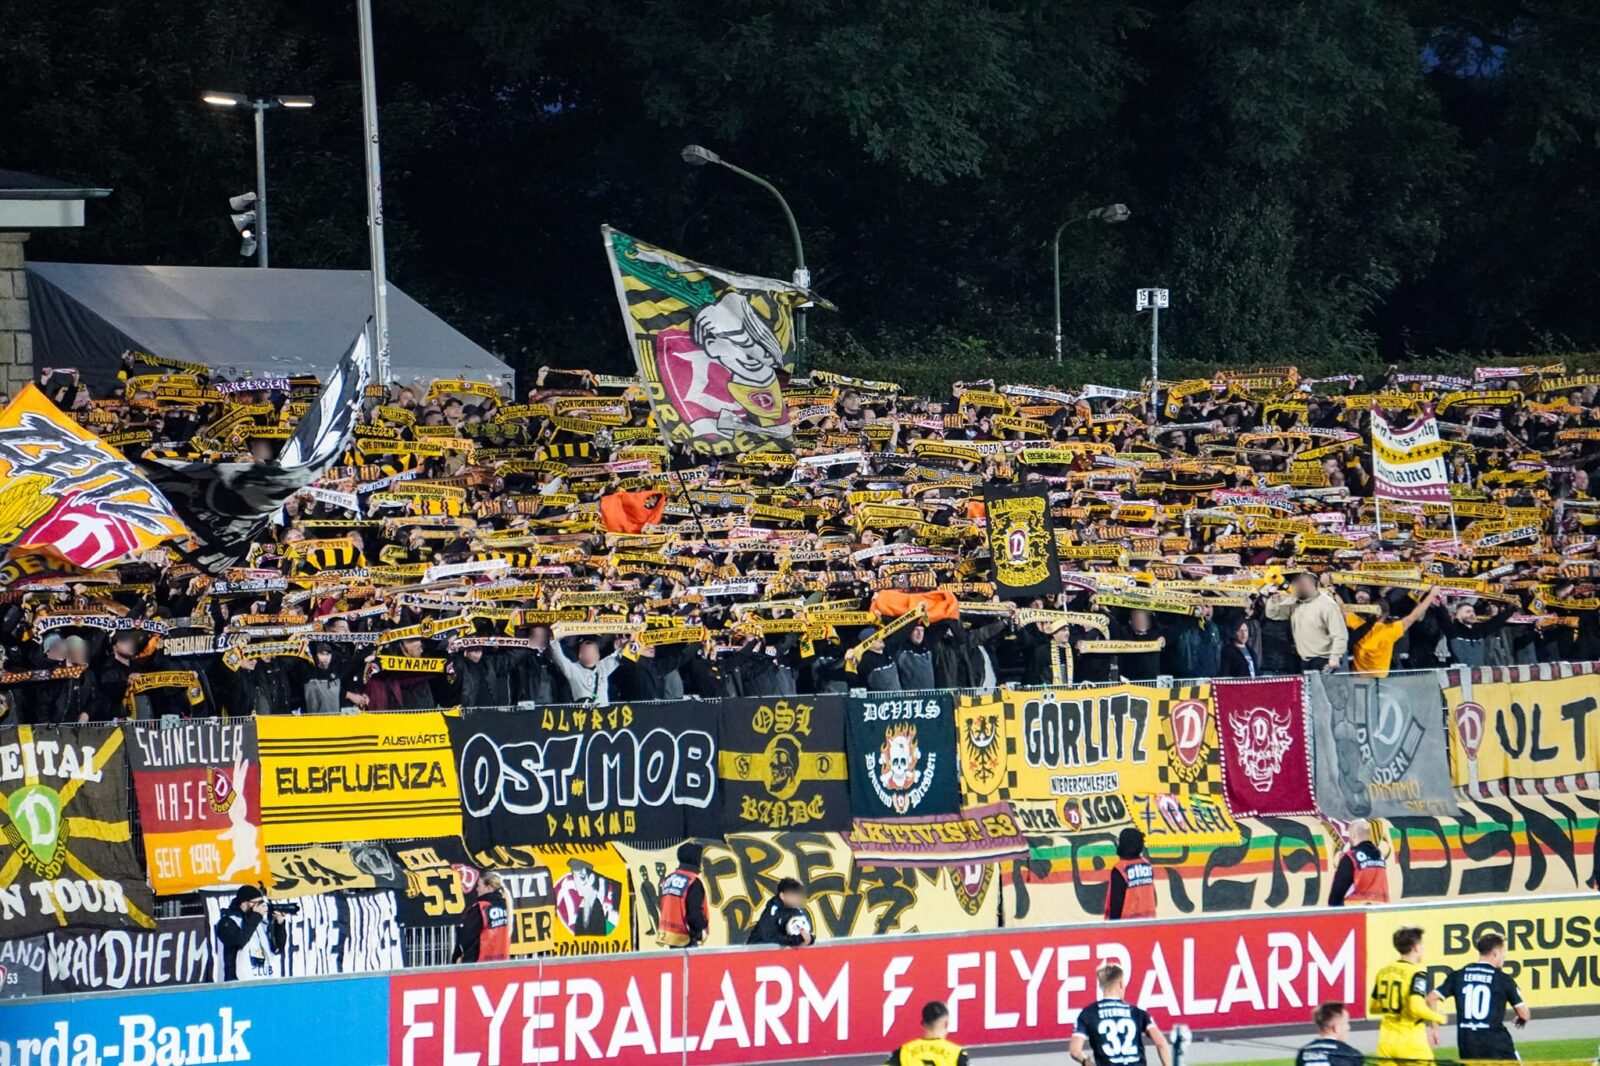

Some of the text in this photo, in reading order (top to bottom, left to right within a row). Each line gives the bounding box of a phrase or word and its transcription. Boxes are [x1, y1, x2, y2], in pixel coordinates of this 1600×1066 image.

[1353, 398, 1403, 407] SACHNPOWER
[744, 620, 803, 632] SAHSENPOWER
[814, 612, 868, 622] SACHSENPOWER
[642, 632, 668, 643] DYNAMO
[387, 659, 437, 671] DYNAMO
[863, 699, 940, 722] DEVILS
[136, 725, 243, 766] SCHNELLER
[1023, 692, 1150, 770] GÖRLITZ
[0, 740, 103, 784] EITAL
[275, 762, 447, 797] ELBFLUENZA
[584, 727, 715, 813] MOB
[1167, 744, 1211, 784] DRESDEN
[155, 781, 207, 822] HASE
[1051, 773, 1119, 796] NIEDERSCHLESIEN
[849, 818, 981, 846] AKTIVIST
[981, 812, 1018, 839] 53
[154, 843, 222, 879] SEIT 1984
[30, 877, 129, 914] TOUR
[419, 869, 466, 917] 53
[1443, 914, 1600, 957] BORUS
[47, 930, 209, 989] WALDHEIM
[401, 960, 850, 1066] FLYERALARM
[1461, 983, 1493, 1022] 10
[1097, 1018, 1140, 1058] 32
